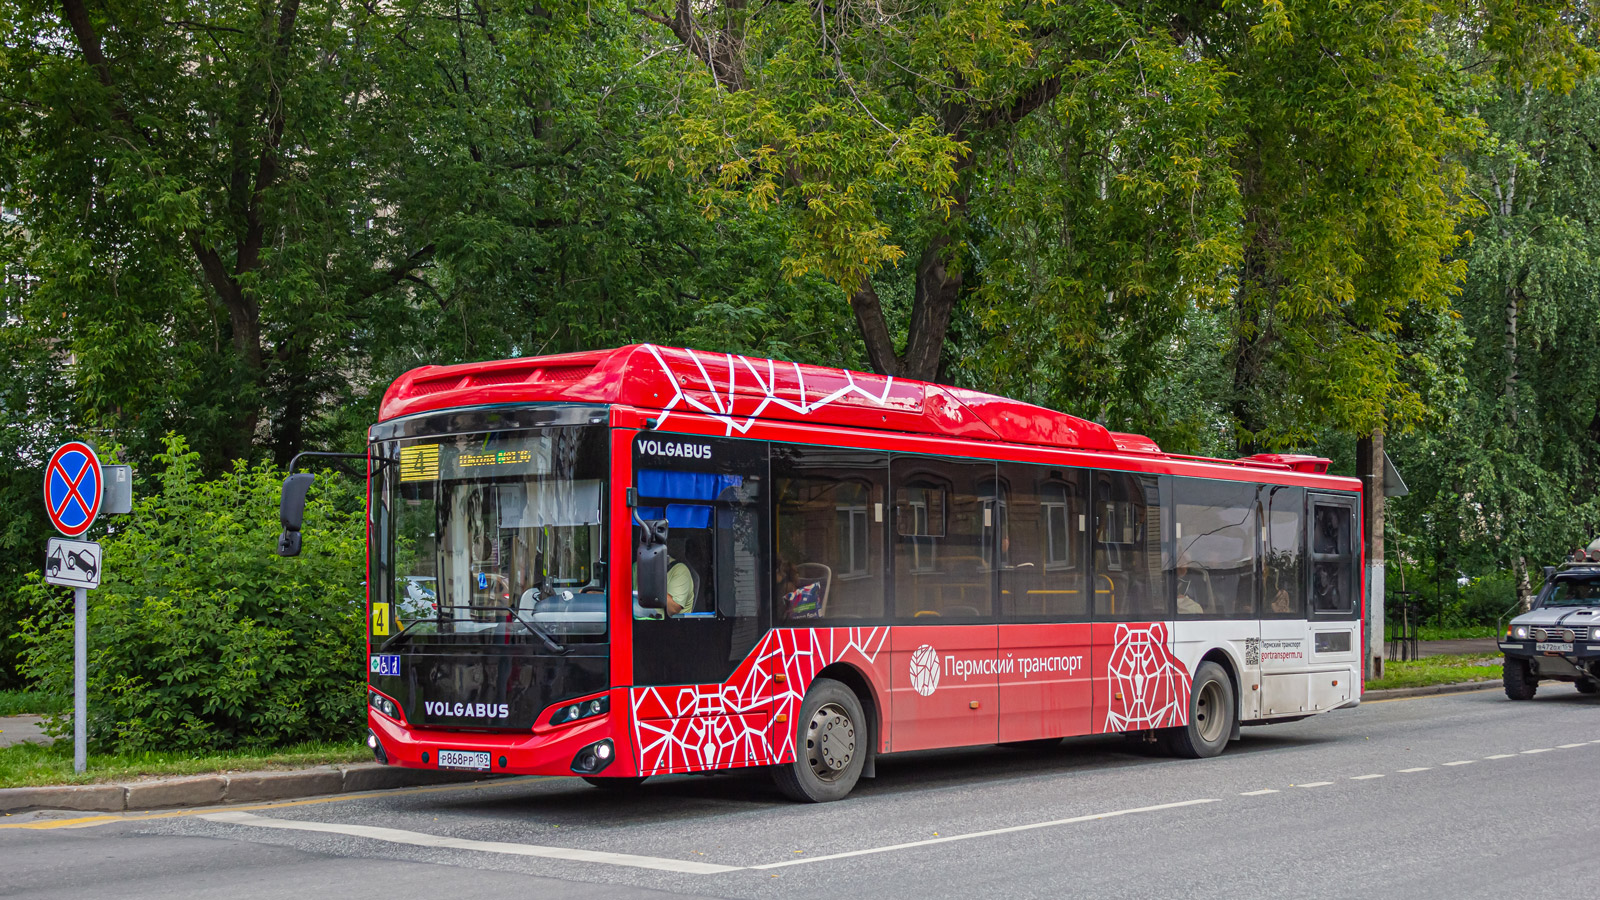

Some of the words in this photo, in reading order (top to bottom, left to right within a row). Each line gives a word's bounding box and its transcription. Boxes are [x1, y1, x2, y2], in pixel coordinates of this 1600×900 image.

[637, 439, 712, 459] VOLGABUS
[413, 451, 426, 474] 4
[376, 607, 385, 632] 4
[1261, 640, 1281, 650] Пермский
[1281, 641, 1302, 650] транспорт
[1261, 652, 1303, 662] gortransperm.ru
[944, 652, 1014, 682] Пермский
[1017, 655, 1083, 679] транспорт
[424, 701, 510, 719] VOLGABUS
[475, 753, 489, 764] 159
